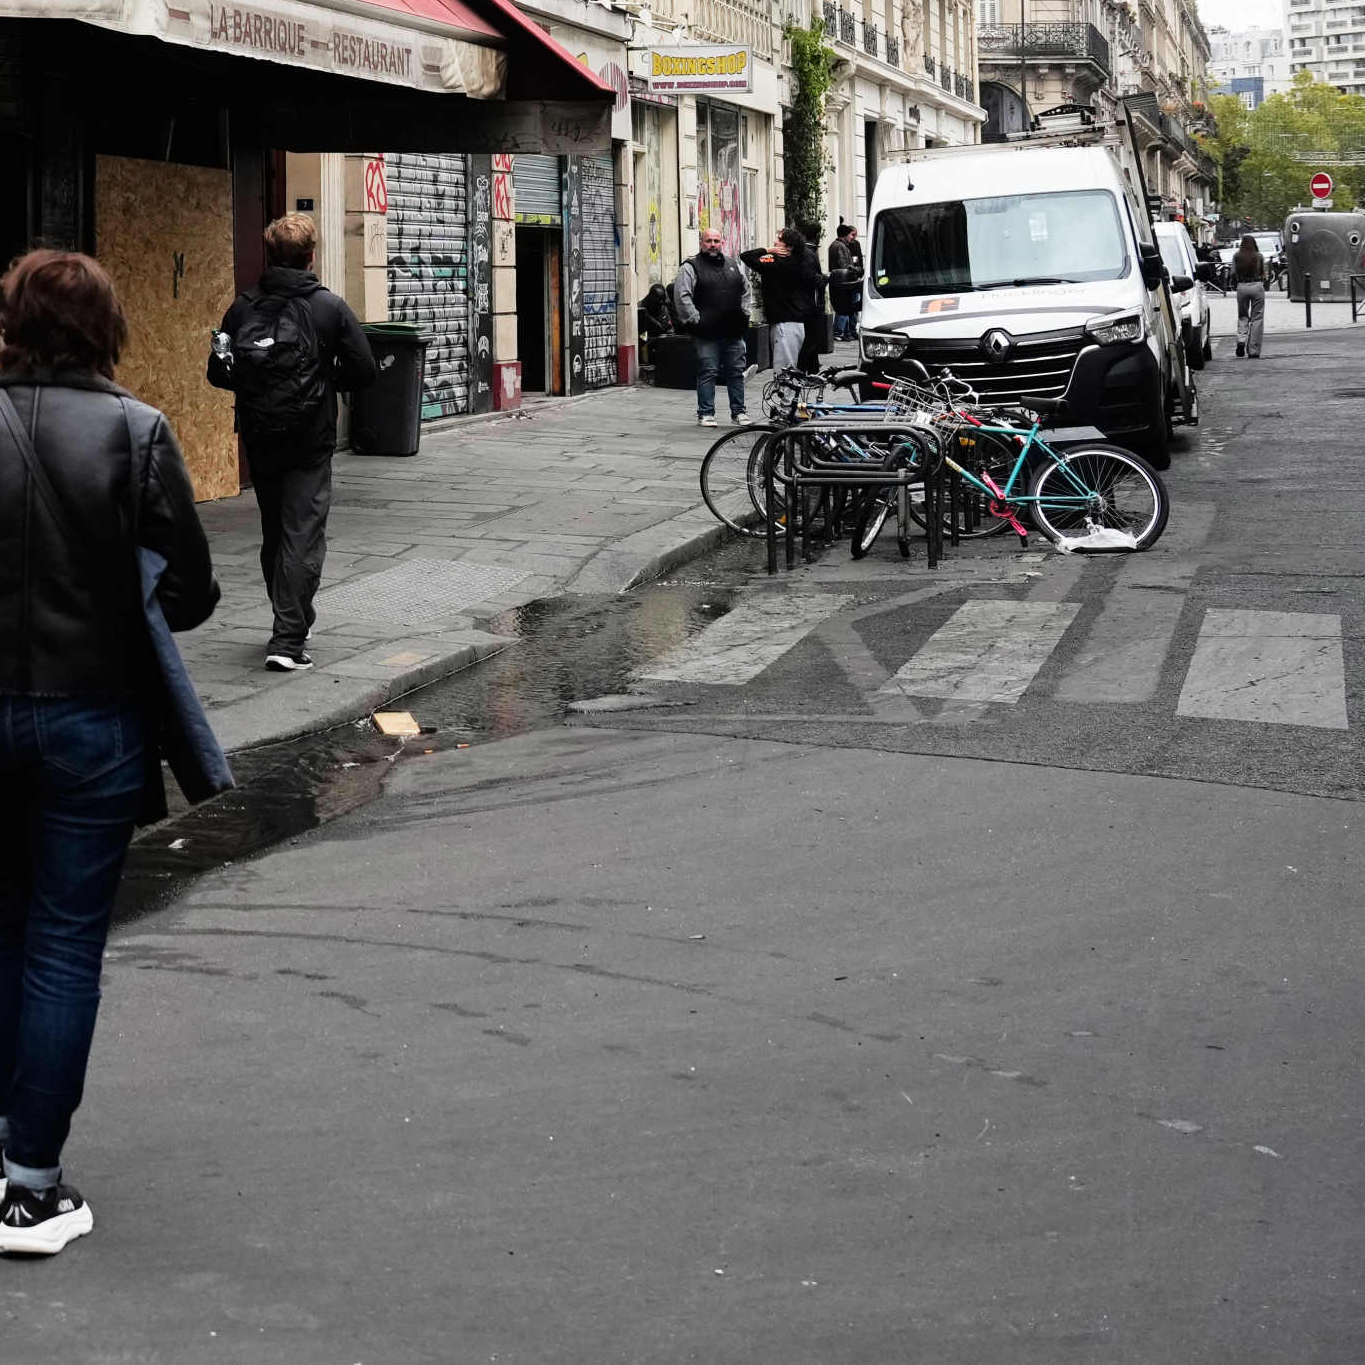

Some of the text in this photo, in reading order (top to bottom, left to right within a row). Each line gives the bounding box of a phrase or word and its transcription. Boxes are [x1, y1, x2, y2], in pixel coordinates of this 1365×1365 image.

[210, 2, 412, 76] LA BARRIQUE RESTAURANT
[652, 51, 747, 76] BOXINGSHOP
